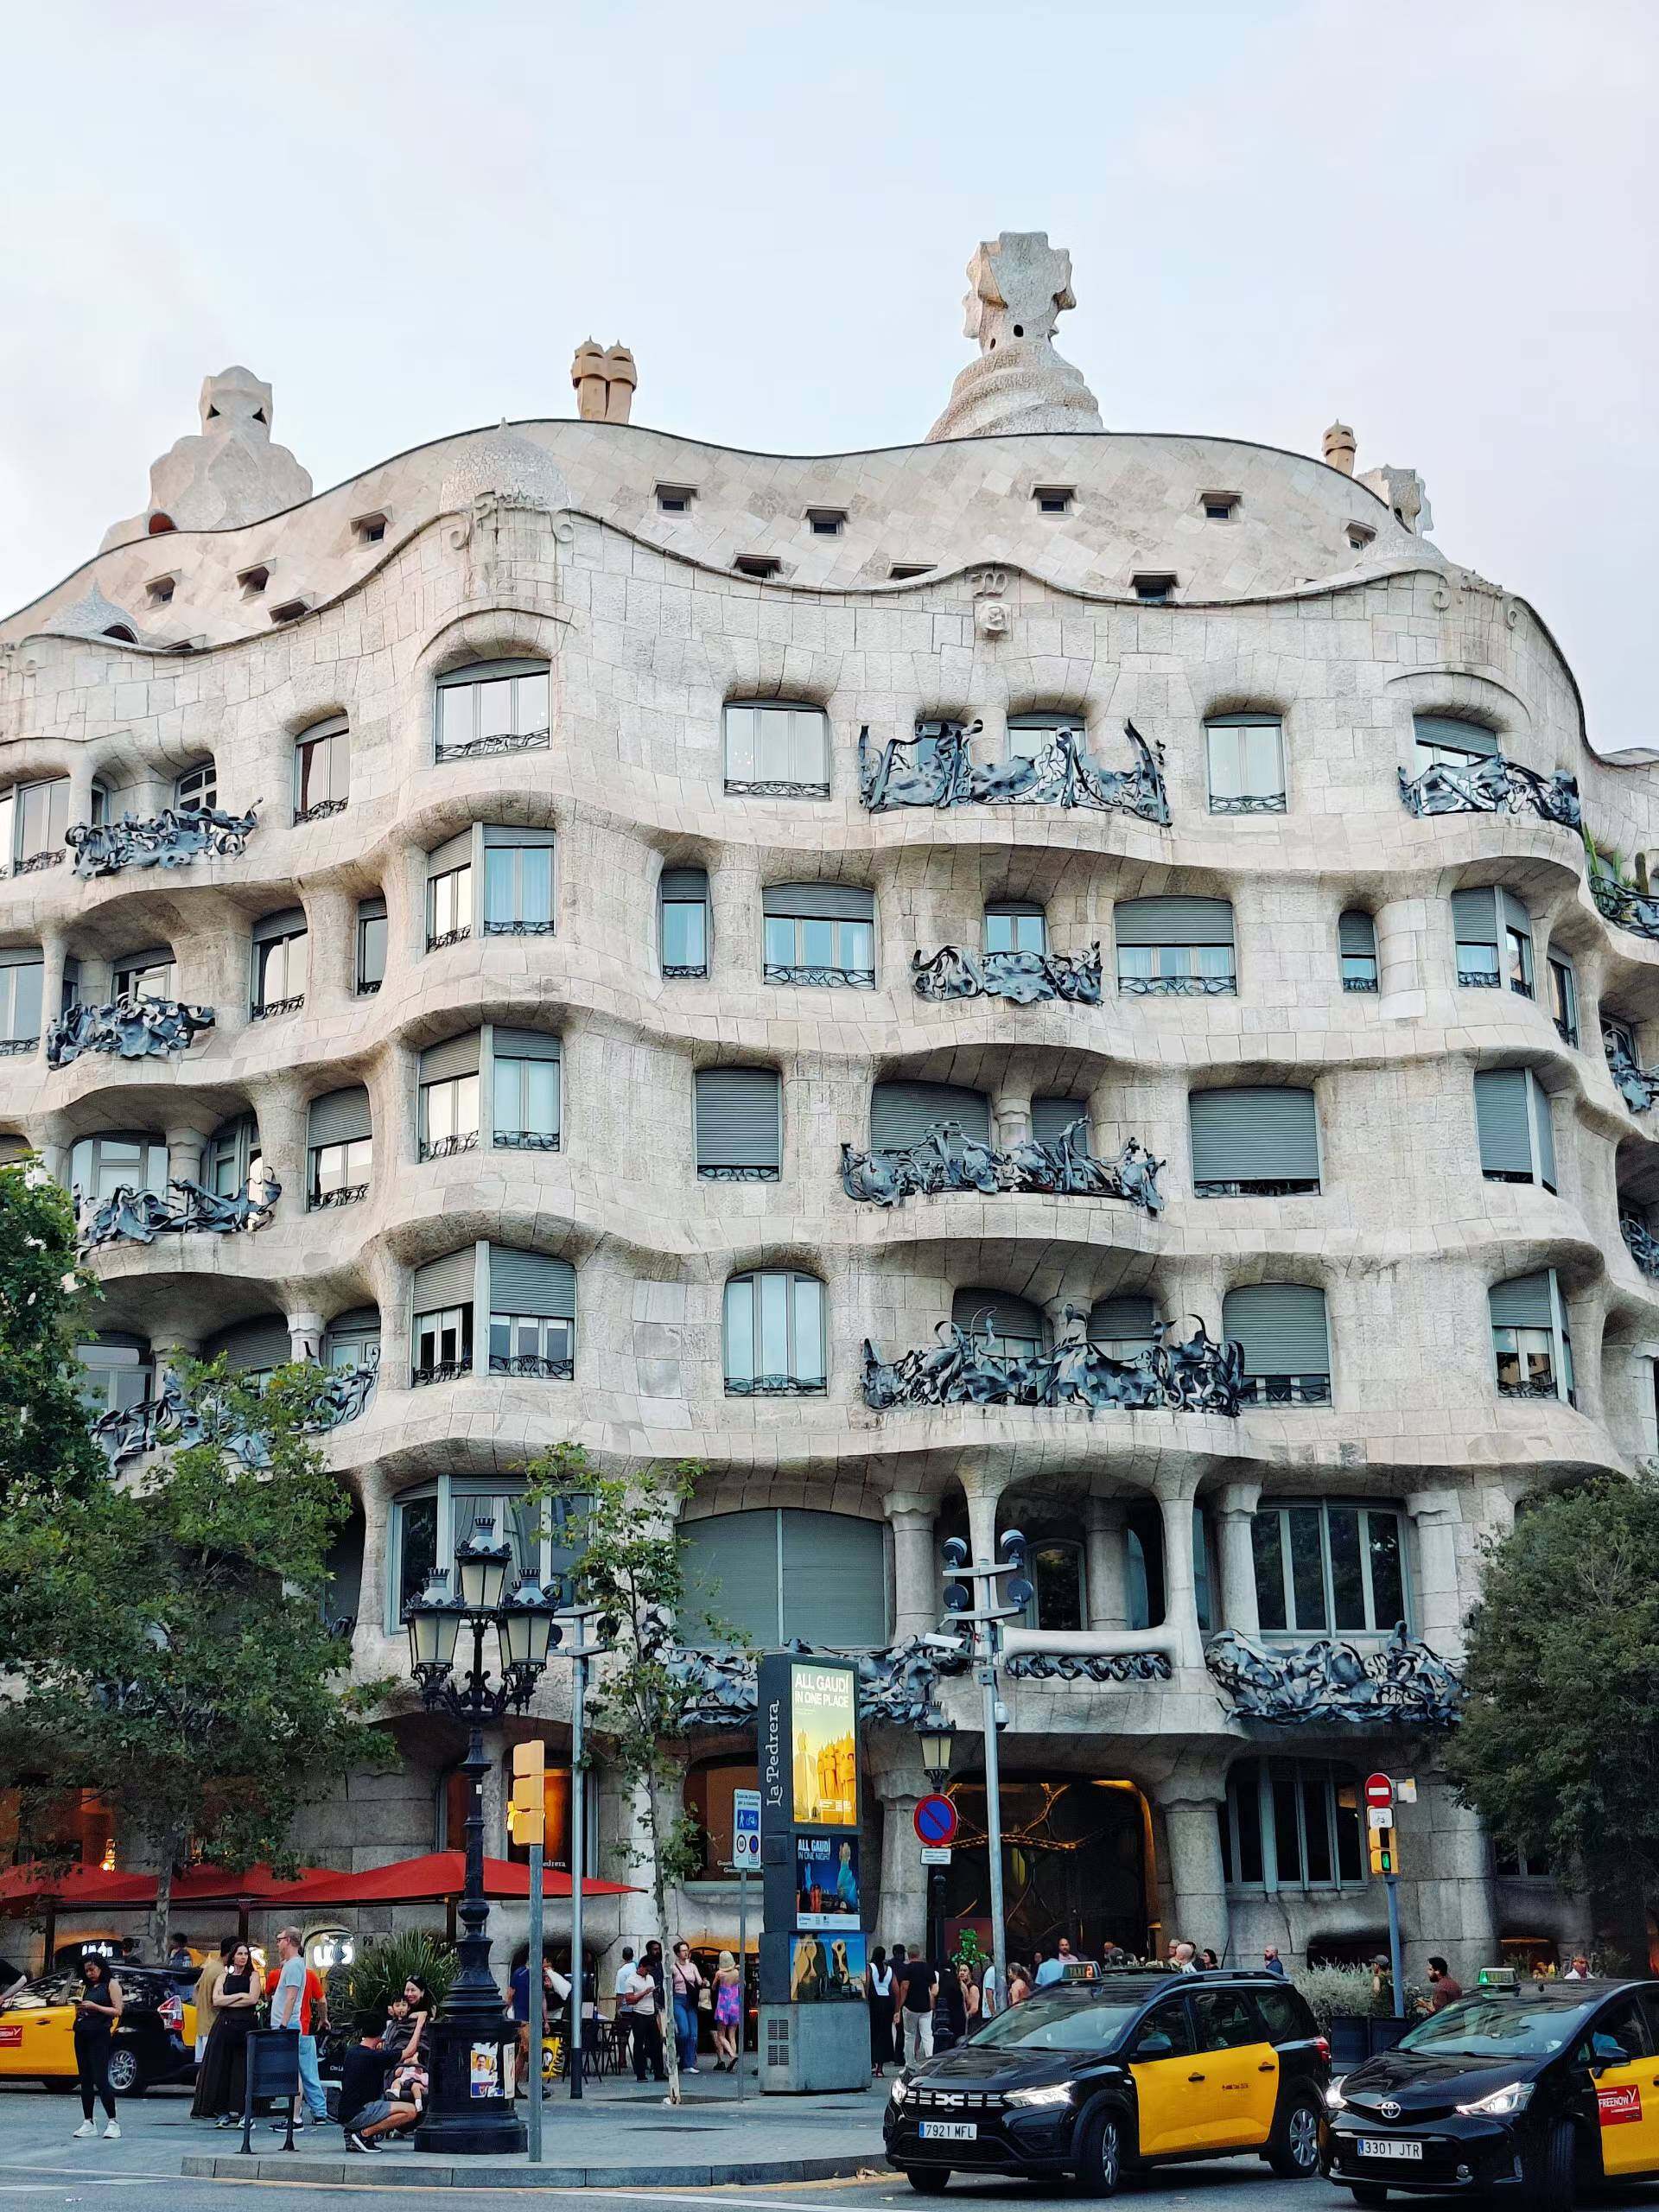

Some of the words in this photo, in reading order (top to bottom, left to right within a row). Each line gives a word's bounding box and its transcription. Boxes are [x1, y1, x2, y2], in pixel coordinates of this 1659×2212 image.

[795, 1672, 815, 1690] ALL
[794, 1690, 804, 1704] IN
[804, 1691, 822, 1706] ONE
[823, 1693, 849, 1708] PLACE
[765, 1699, 779, 1783] Pedrera
[766, 1783, 784, 1807] La
[798, 1839, 810, 1852] ALL
[543, 1859, 566, 1867] edrera
[926, 2124, 950, 2137] 7921
[955, 2126, 974, 2139] MFL
[1365, 2141, 1392, 2155] 3301
[1400, 2143, 1420, 2158] JTR
